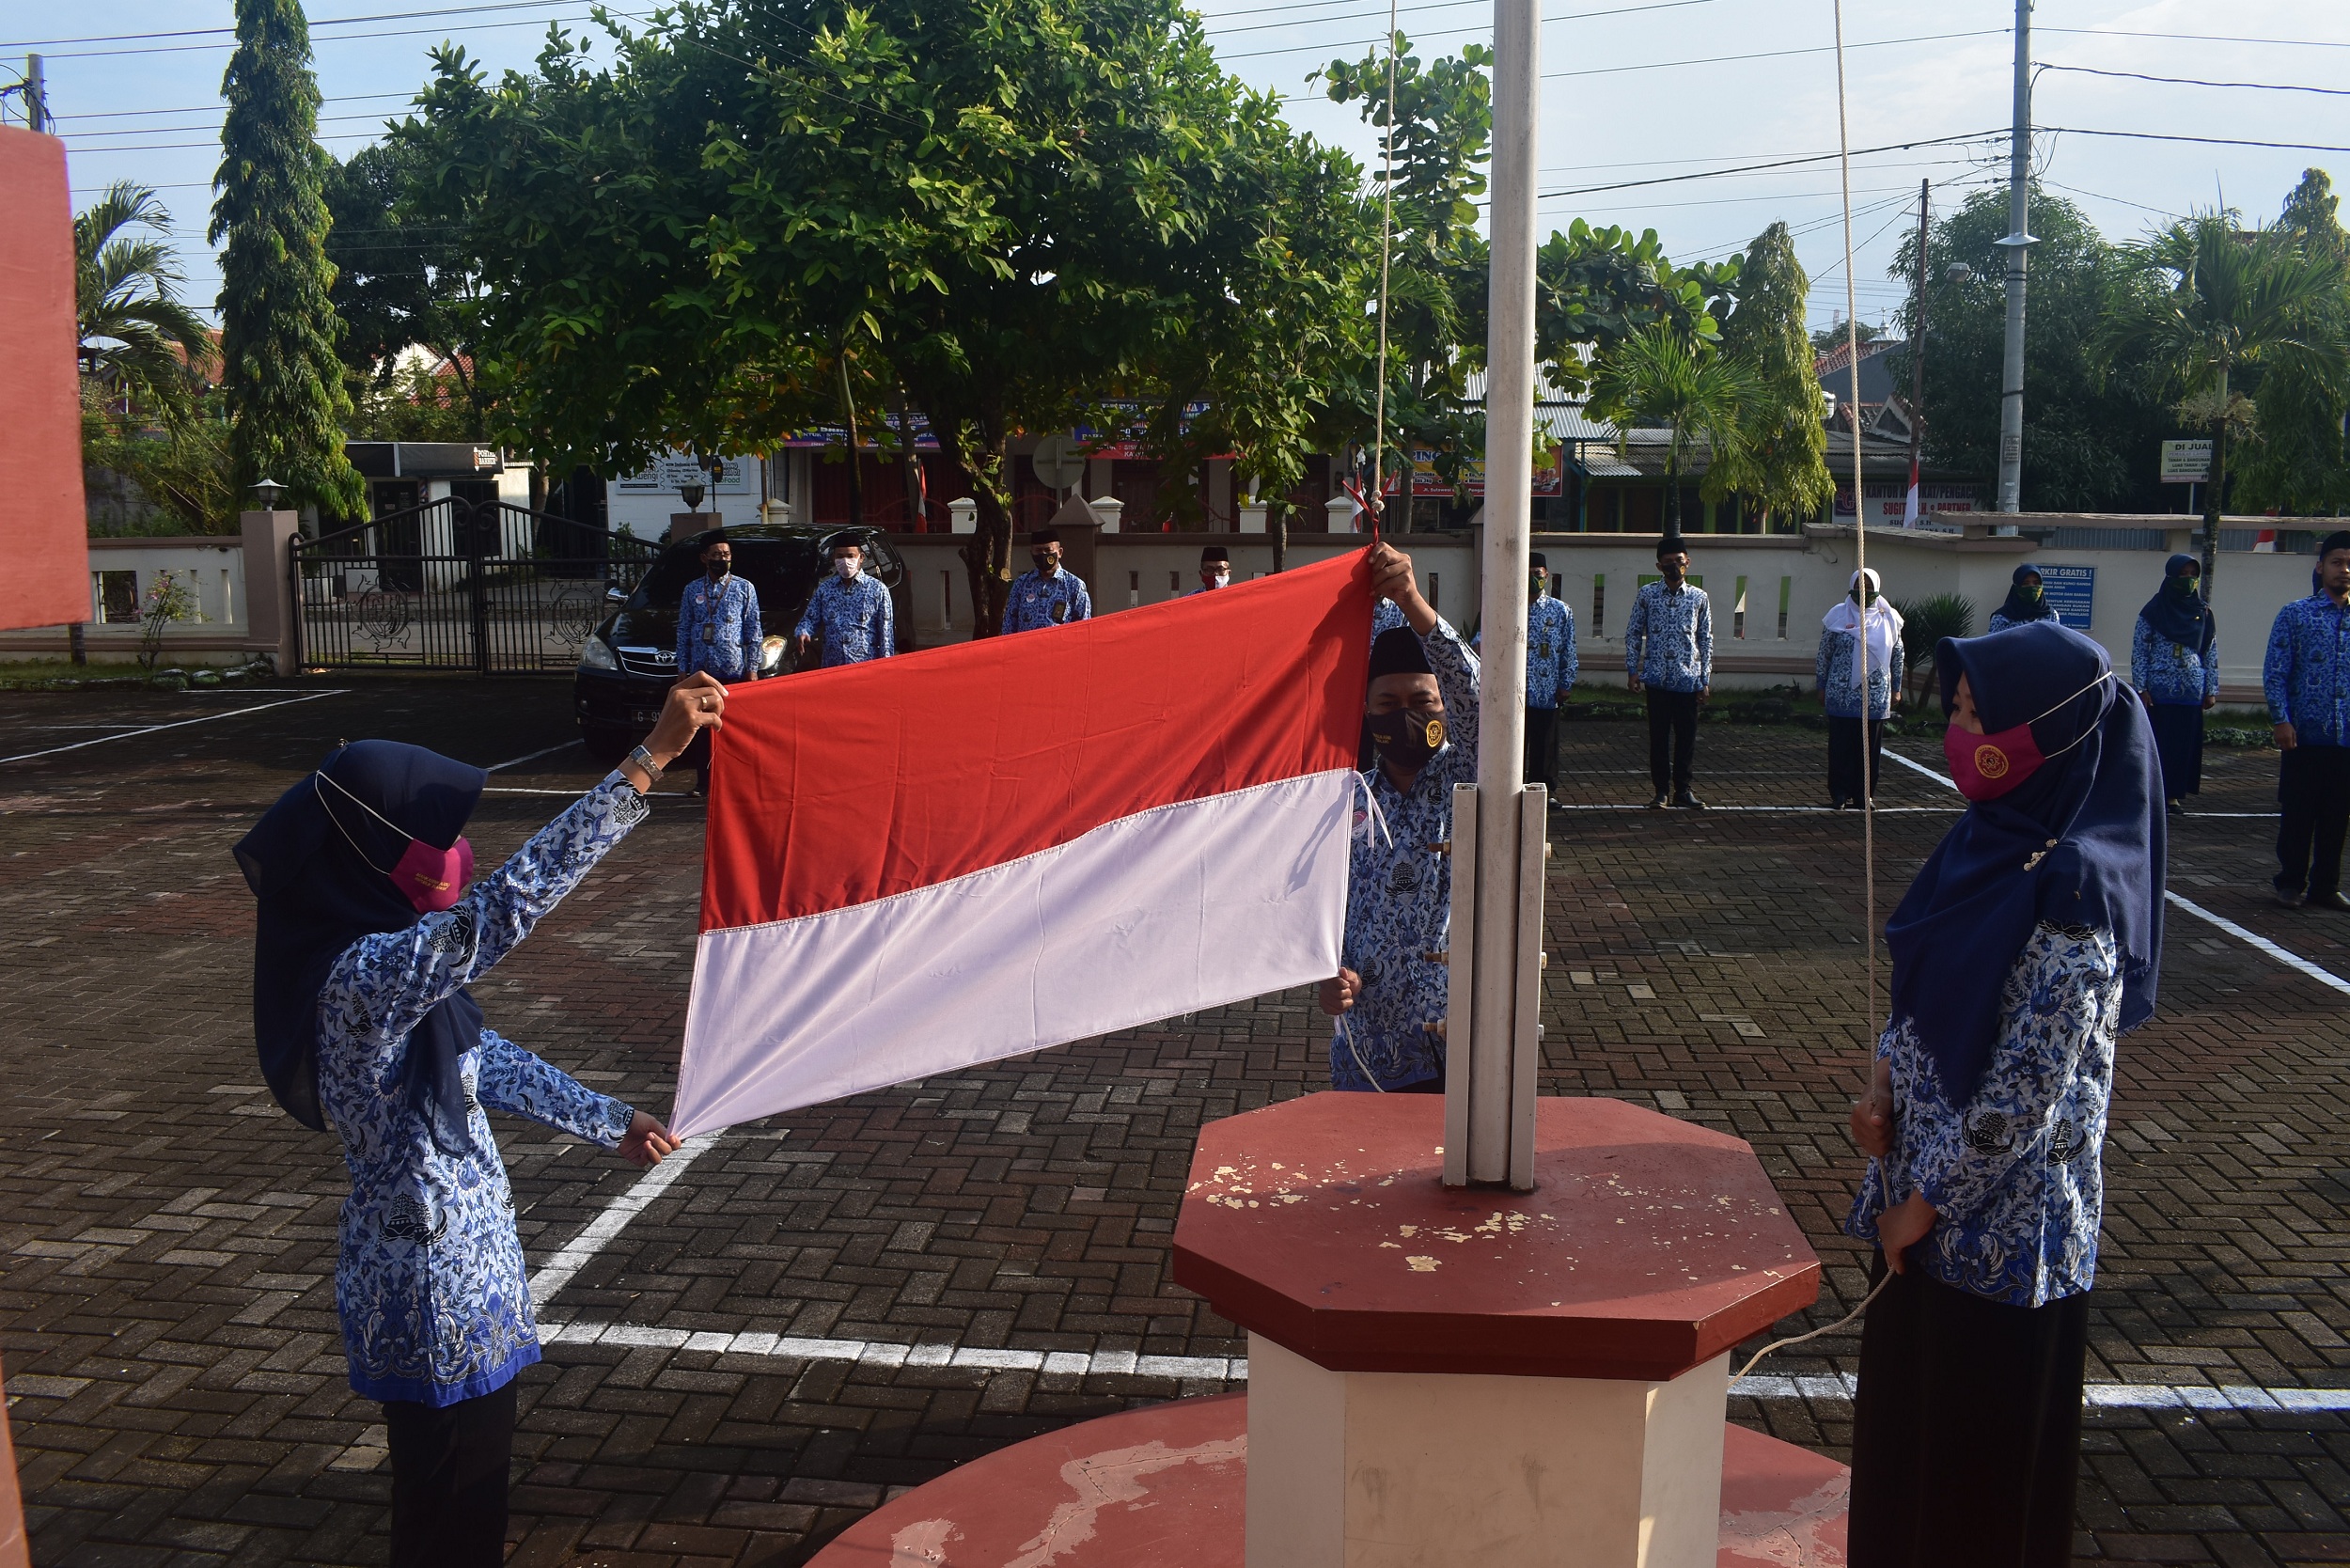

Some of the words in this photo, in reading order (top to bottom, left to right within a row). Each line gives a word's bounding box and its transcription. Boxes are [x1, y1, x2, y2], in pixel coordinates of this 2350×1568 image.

[1866, 484, 1898, 498] KANTOR
[1883, 502, 1907, 515] SUGIT
[2040, 568, 2059, 576] RKIR
[2060, 568, 2087, 577] GRATIS
[637, 711, 644, 722] G
